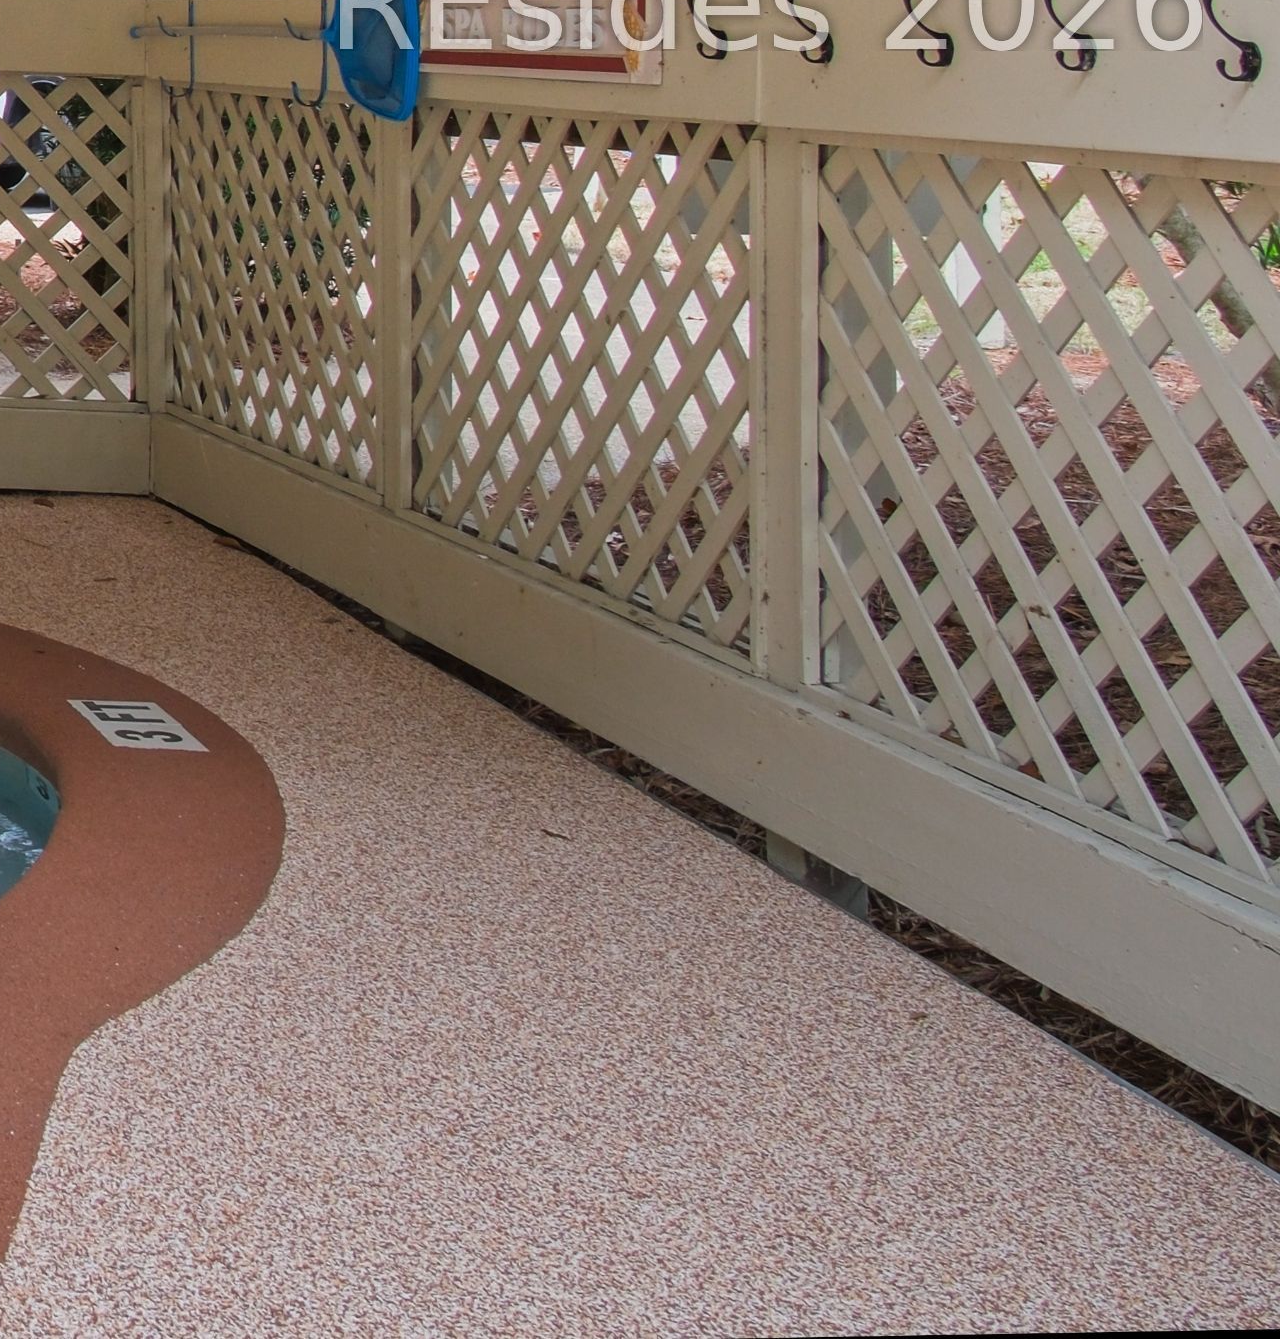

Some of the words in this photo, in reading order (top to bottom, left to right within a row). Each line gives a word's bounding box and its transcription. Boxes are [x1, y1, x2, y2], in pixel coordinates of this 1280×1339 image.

[439, 6, 484, 46] SPA
[81, 701, 167, 724] FT
[115, 730, 183, 743] 3
